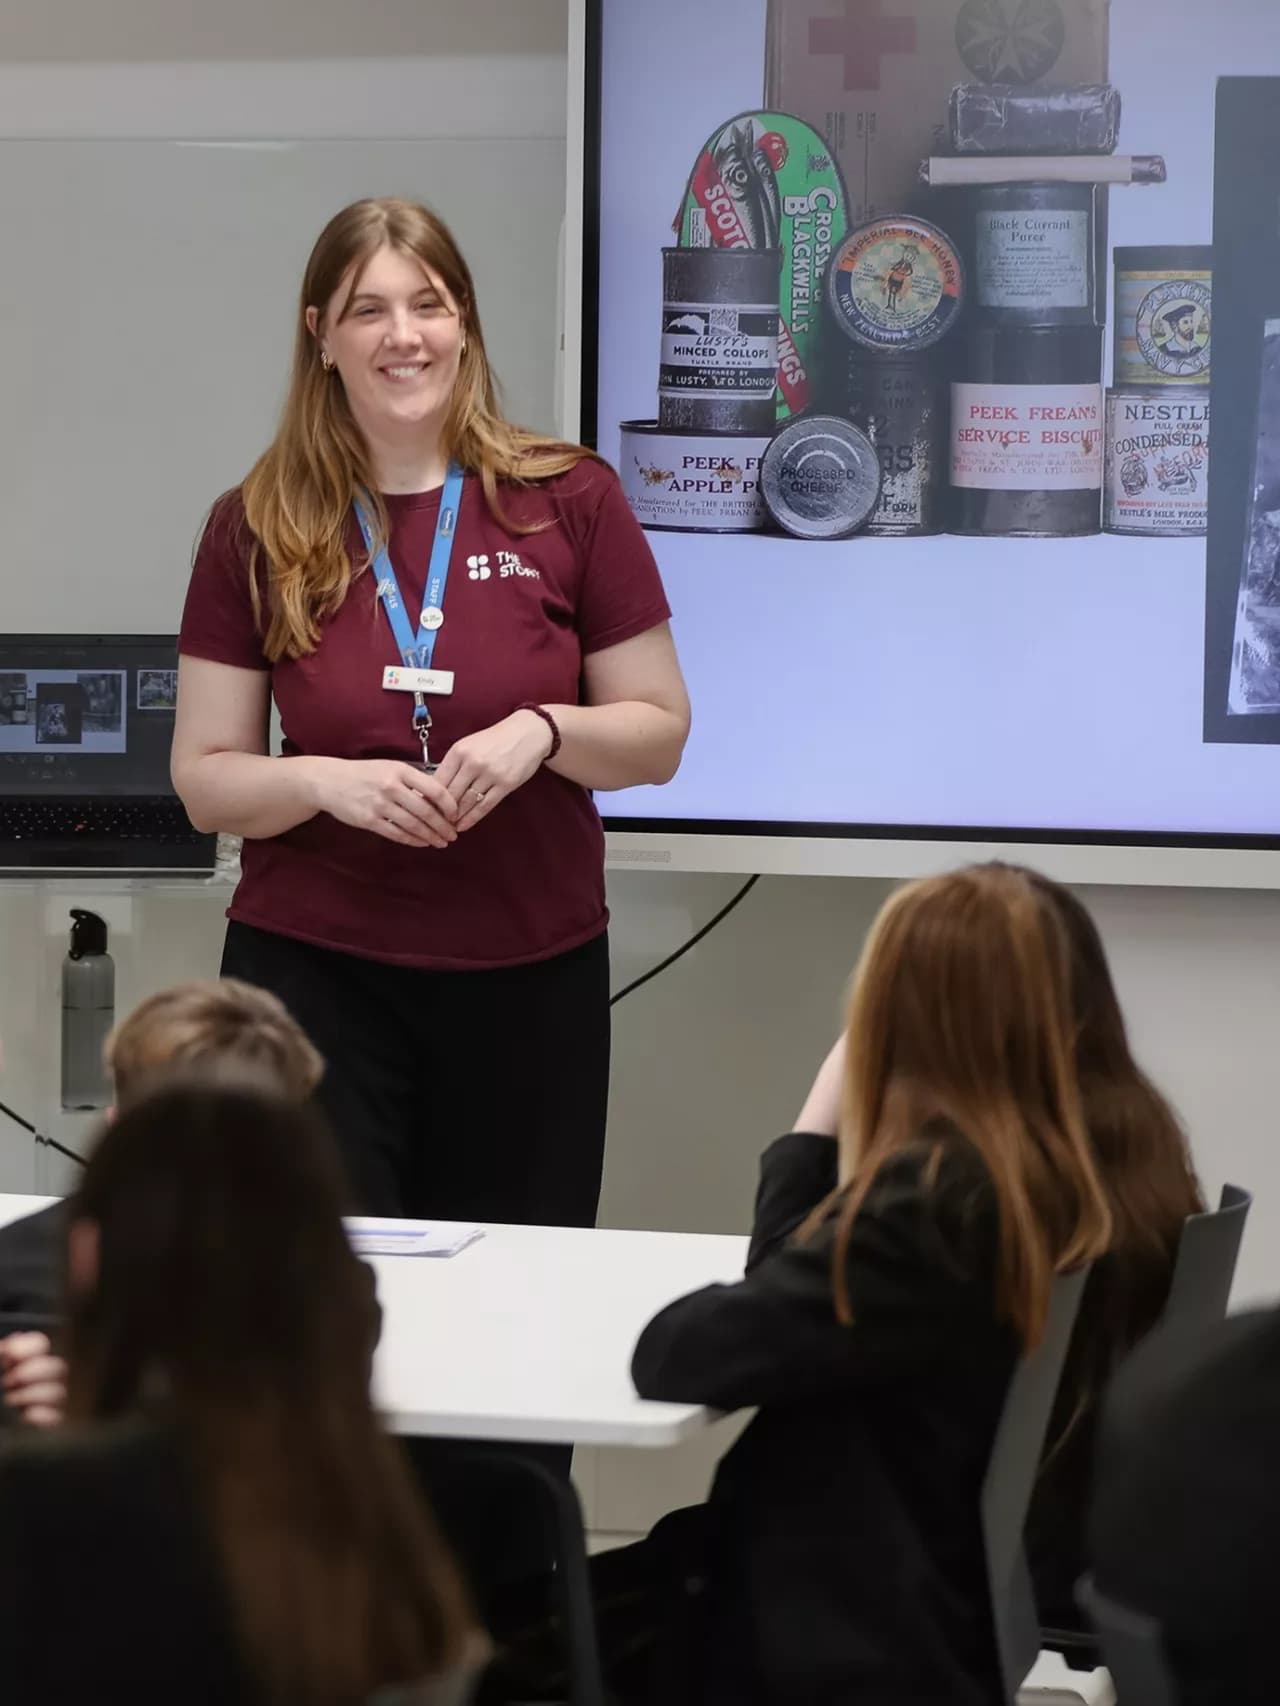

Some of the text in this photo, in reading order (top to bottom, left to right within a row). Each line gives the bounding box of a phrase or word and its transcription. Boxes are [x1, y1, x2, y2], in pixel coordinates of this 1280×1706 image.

[808, 187, 836, 278] CROSSE
[784, 196, 814, 333] BLACKWELL'S
[840, 293, 856, 316] NEW
[696, 335, 749, 346] LUSTY'S
[673, 346, 769, 359] MINCED COLLOPS
[970, 405, 1097, 421] PEEK FREAN'S
[958, 428, 1031, 443] SERVICE
[1115, 433, 1202, 454] CONDENSED
[682, 456, 734, 470] PEEK
[668, 479, 733, 493] APPLE
